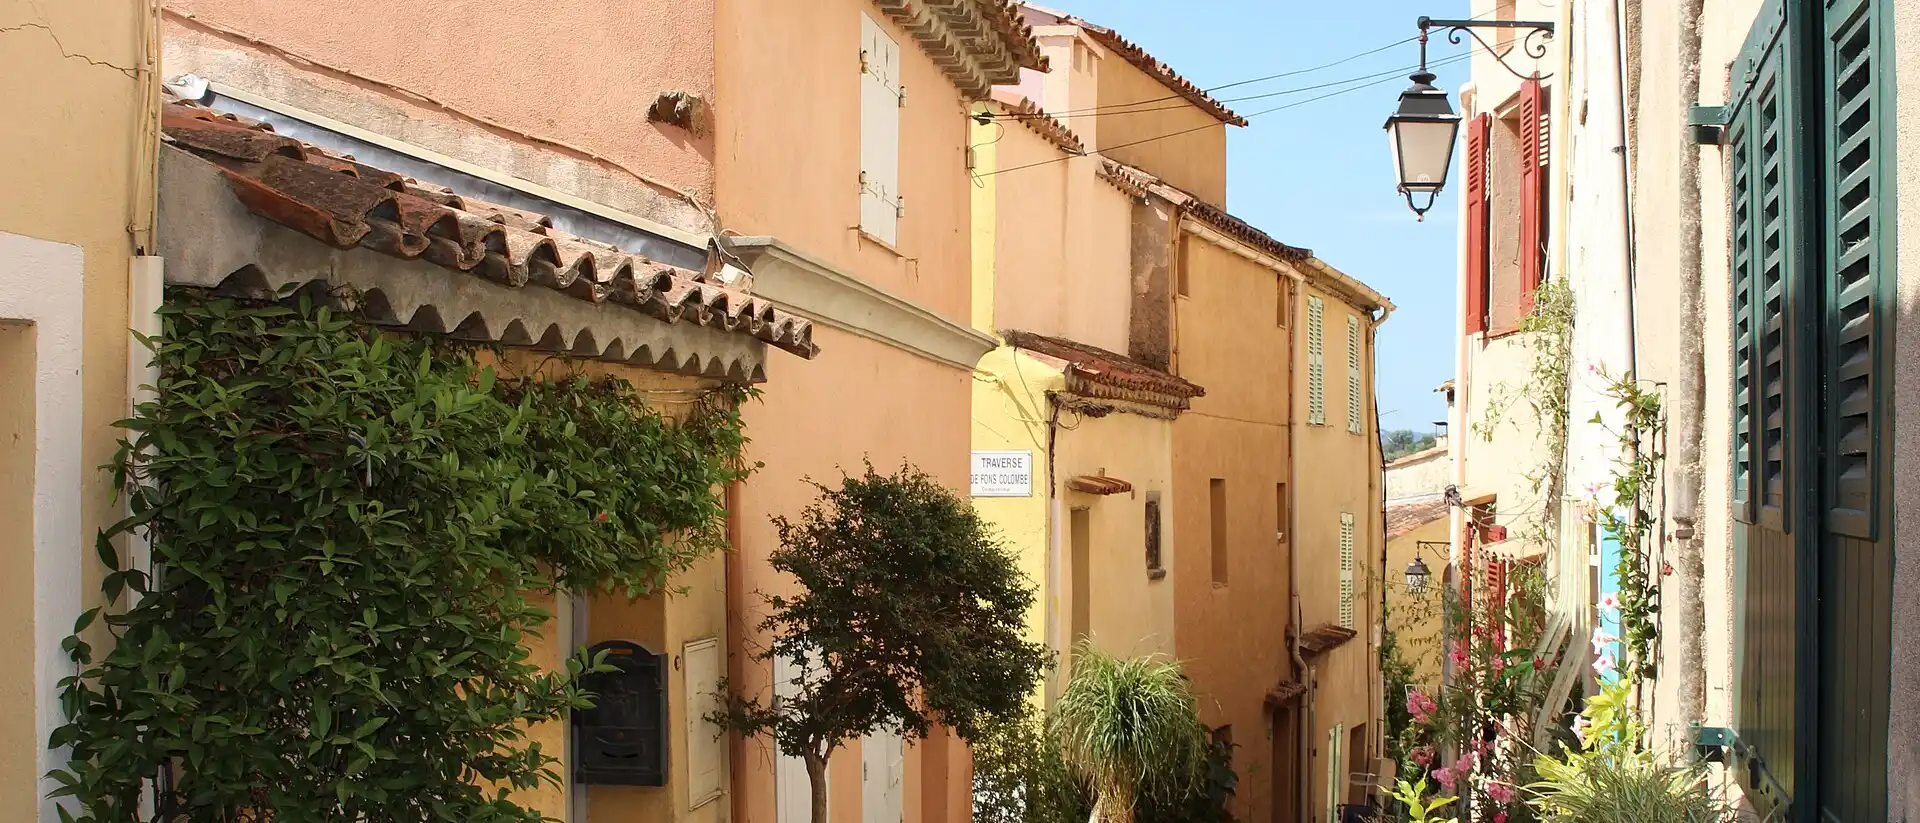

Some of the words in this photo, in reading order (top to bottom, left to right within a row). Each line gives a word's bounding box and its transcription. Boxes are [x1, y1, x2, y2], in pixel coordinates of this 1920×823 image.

[981, 457, 1023, 468] TRAVERSE
[970, 474, 979, 485] DE
[980, 474, 997, 485] FONS
[999, 474, 1028, 485] COLOMBE
